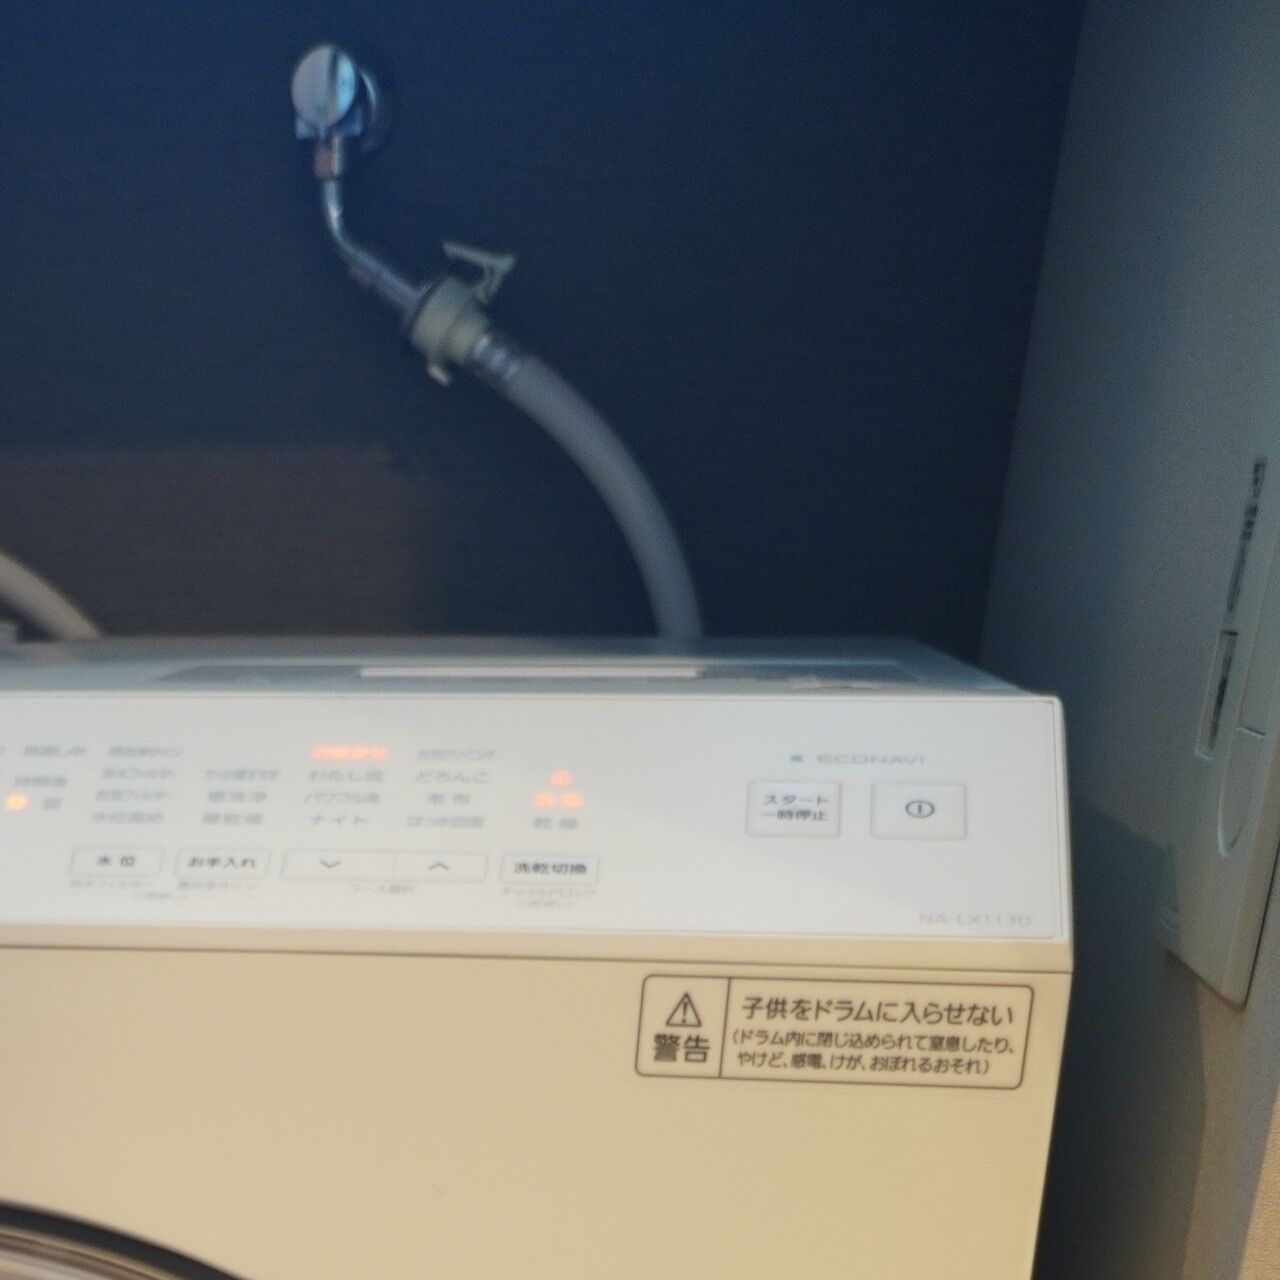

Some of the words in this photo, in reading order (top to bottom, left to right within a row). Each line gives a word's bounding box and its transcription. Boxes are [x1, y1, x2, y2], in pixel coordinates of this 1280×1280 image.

[816, 753, 926, 766] ECONAVI
[762, 793, 830, 807] スタート
[761, 808, 829, 823] 一時停止
[741, 996, 1013, 1026] 子供をドラムに入らせない
[652, 1032, 712, 1064] 警告
[732, 1029, 1014, 1055] （ドラム内に閉じ込められて窒息したり、
[736, 1053, 992, 1076] やけど、感電、けが、おぼれるおそれ）
